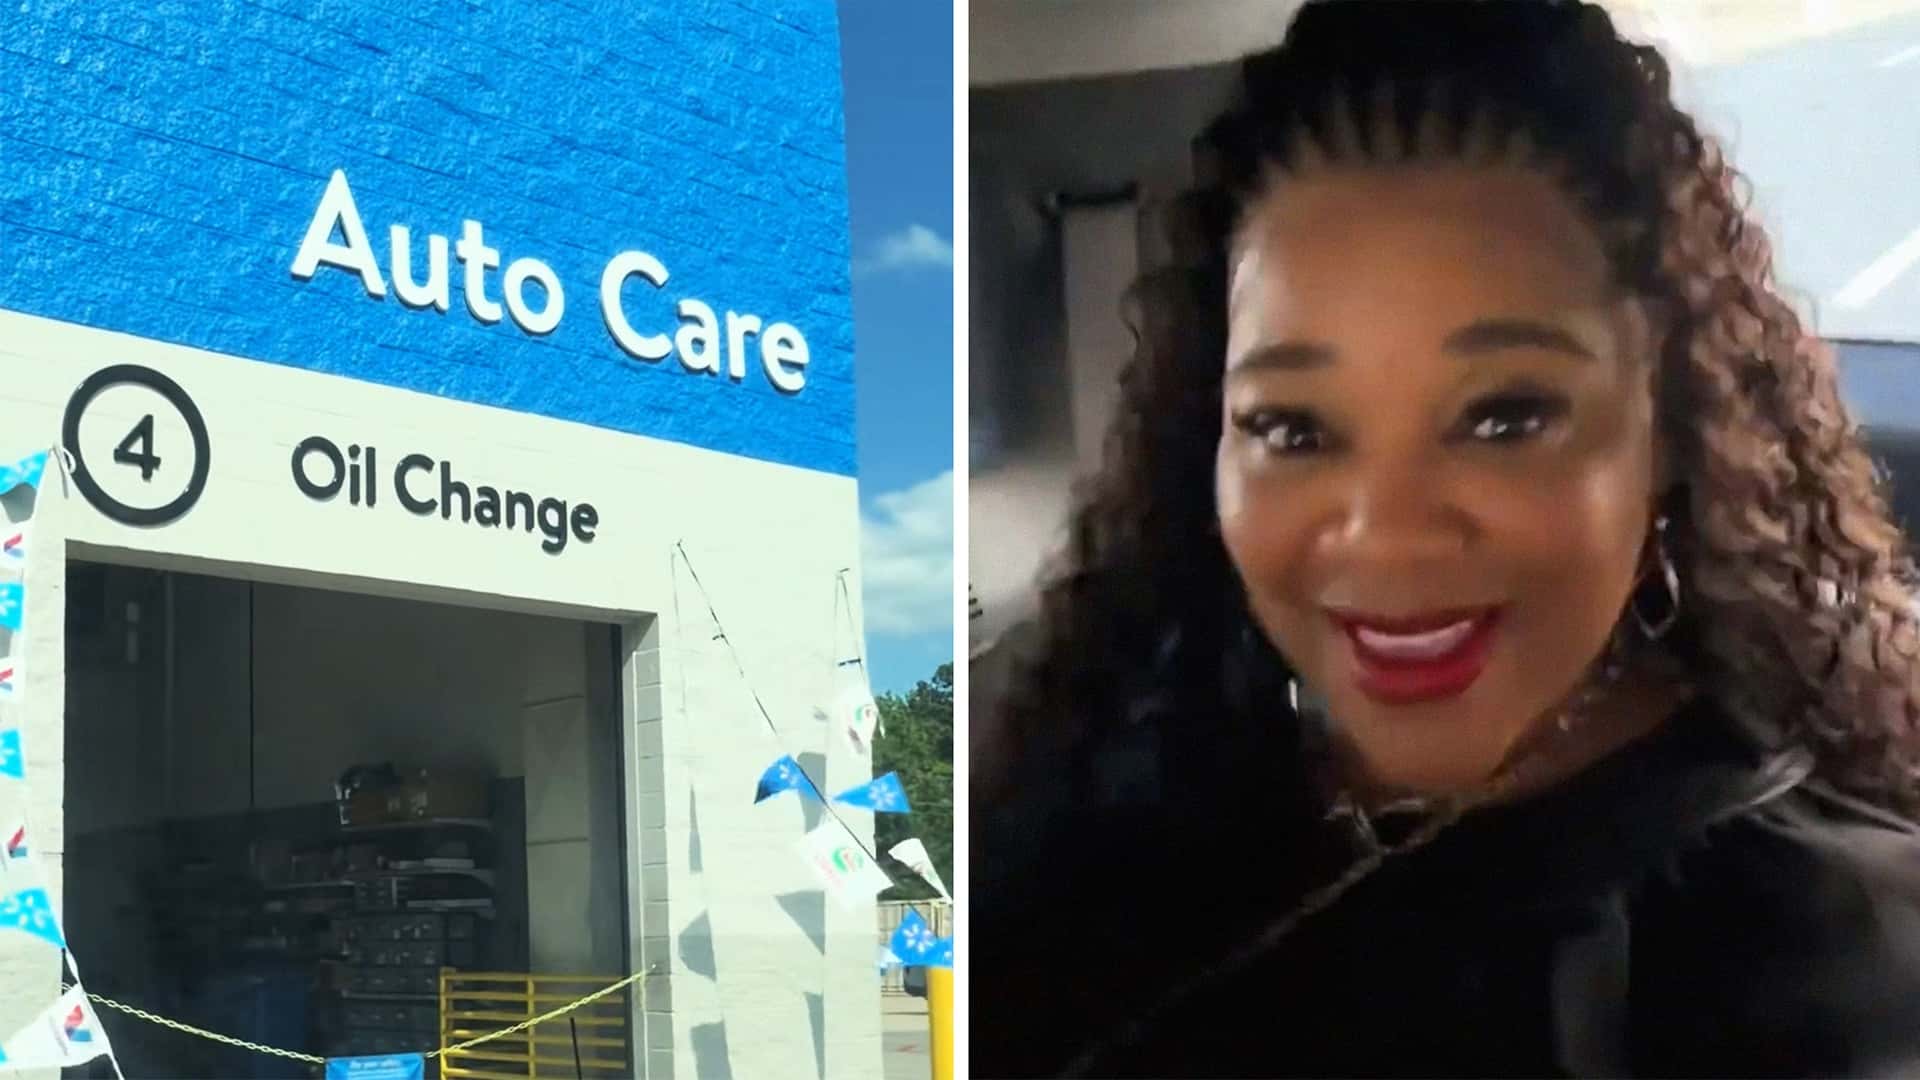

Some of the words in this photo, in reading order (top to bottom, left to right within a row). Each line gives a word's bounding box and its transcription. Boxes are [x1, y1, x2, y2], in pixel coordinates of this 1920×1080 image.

[290, 168, 566, 334] Auto
[600, 250, 811, 393] Care
[113, 413, 161, 481] 4
[291, 436, 377, 507] Oil
[393, 453, 600, 555] Change
